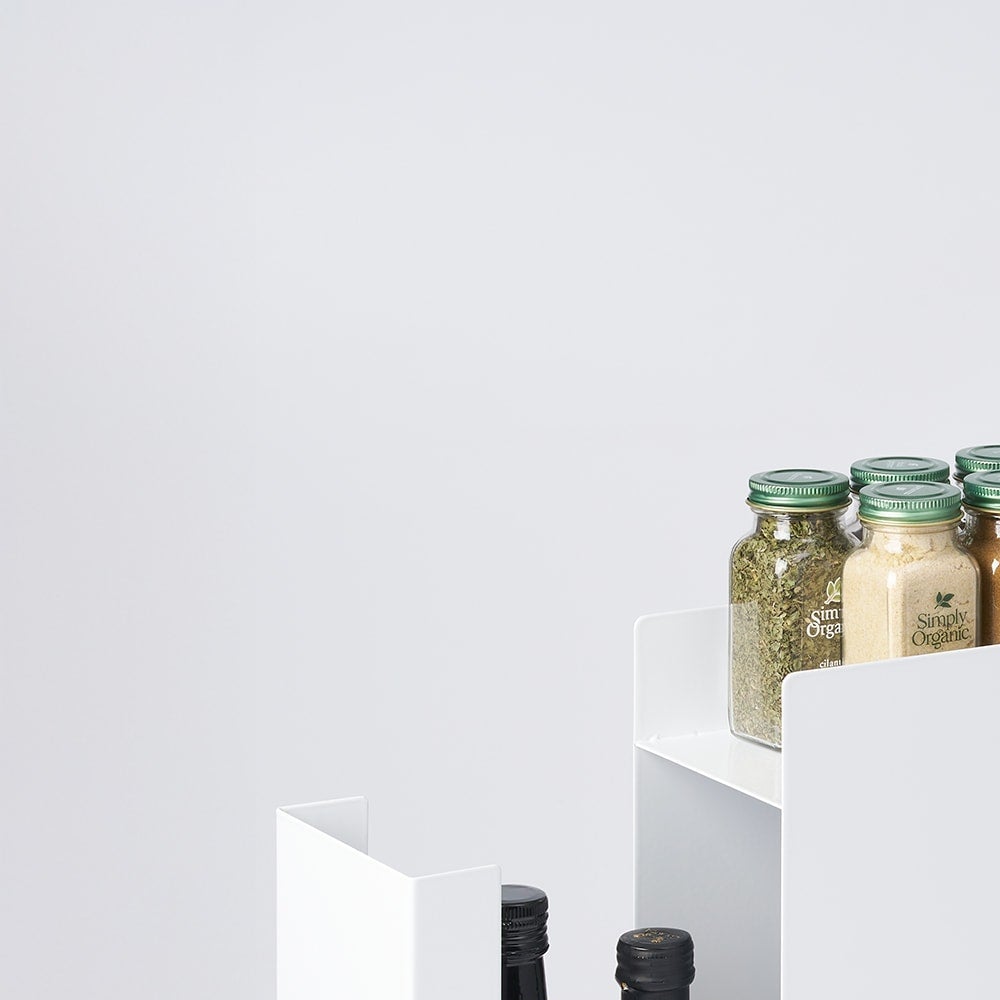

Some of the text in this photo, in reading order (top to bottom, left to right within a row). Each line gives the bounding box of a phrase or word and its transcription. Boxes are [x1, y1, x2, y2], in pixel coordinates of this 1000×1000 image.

[811, 605, 841, 626] Sim
[917, 609, 968, 631] Simply
[912, 627, 970, 649] Organic
